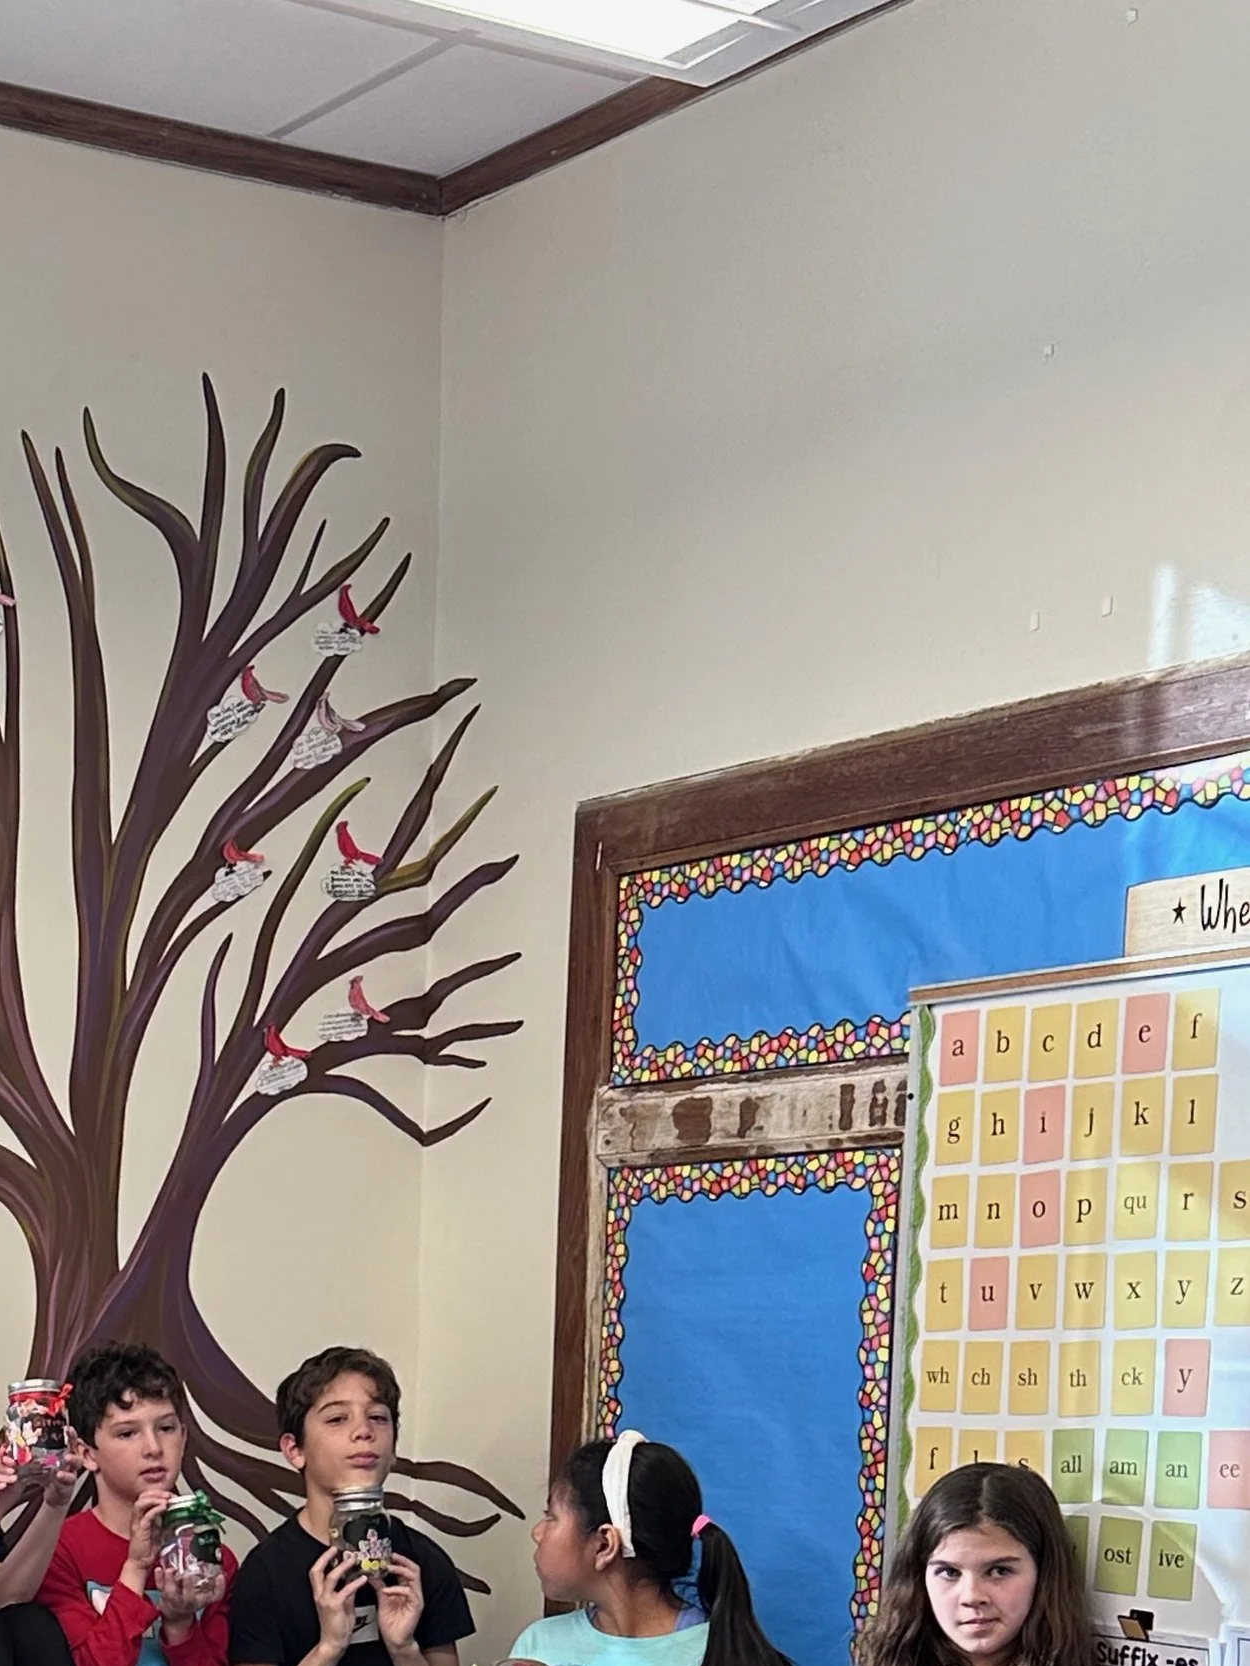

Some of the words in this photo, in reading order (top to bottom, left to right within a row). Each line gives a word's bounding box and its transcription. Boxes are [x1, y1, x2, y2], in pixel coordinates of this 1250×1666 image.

[952, 1039, 964, 1056] a
[997, 1030, 1010, 1053] b
[1043, 1034, 1054, 1052] c
[1088, 1024, 1101, 1048] d
[1139, 1024, 1151, 1042] e
[1190, 1013, 1202, 1038] f
[947, 1117, 961, 1144] g
[991, 1113, 1005, 1135] h
[1040, 1111, 1046, 1133] i
[1085, 1108, 1094, 1137] j
[1134, 1101, 1149, 1125] k
[1188, 1100, 1195, 1124] l
[938, 1202, 958, 1220] m
[987, 1202, 1000, 1219] n
[1033, 1200, 1045, 1217] o
[1077, 1198, 1092, 1223] p
[1124, 1195, 1146, 1214] qu
[1182, 1191, 1193, 1210] r
[1234, 1191, 1247, 1209] s
[940, 1282, 947, 1303] t
[982, 1284, 994, 1302] u
[1030, 1283, 1042, 1300] v
[1075, 1281, 1094, 1299] w
[1127, 1280, 1141, 1299] x
[1176, 1279, 1192, 1304] y
[1230, 1277, 1244, 1296] z
[926, 1367, 949, 1384] wh
[971, 1368, 991, 1385] ch
[1018, 1368, 1038, 1386] sh
[1069, 1369, 1087, 1387] th
[1121, 1367, 1144, 1386] ck
[1177, 1368, 1193, 1393] y
[929, 1448, 938, 1469] f
[1061, 1455, 1082, 1473] all
[1110, 1459, 1137, 1476] am
[1166, 1461, 1188, 1478] an
[1220, 1462, 1239, 1478] ee
[1105, 1546, 1133, 1565] ost
[1158, 1551, 1184, 1568] ive
